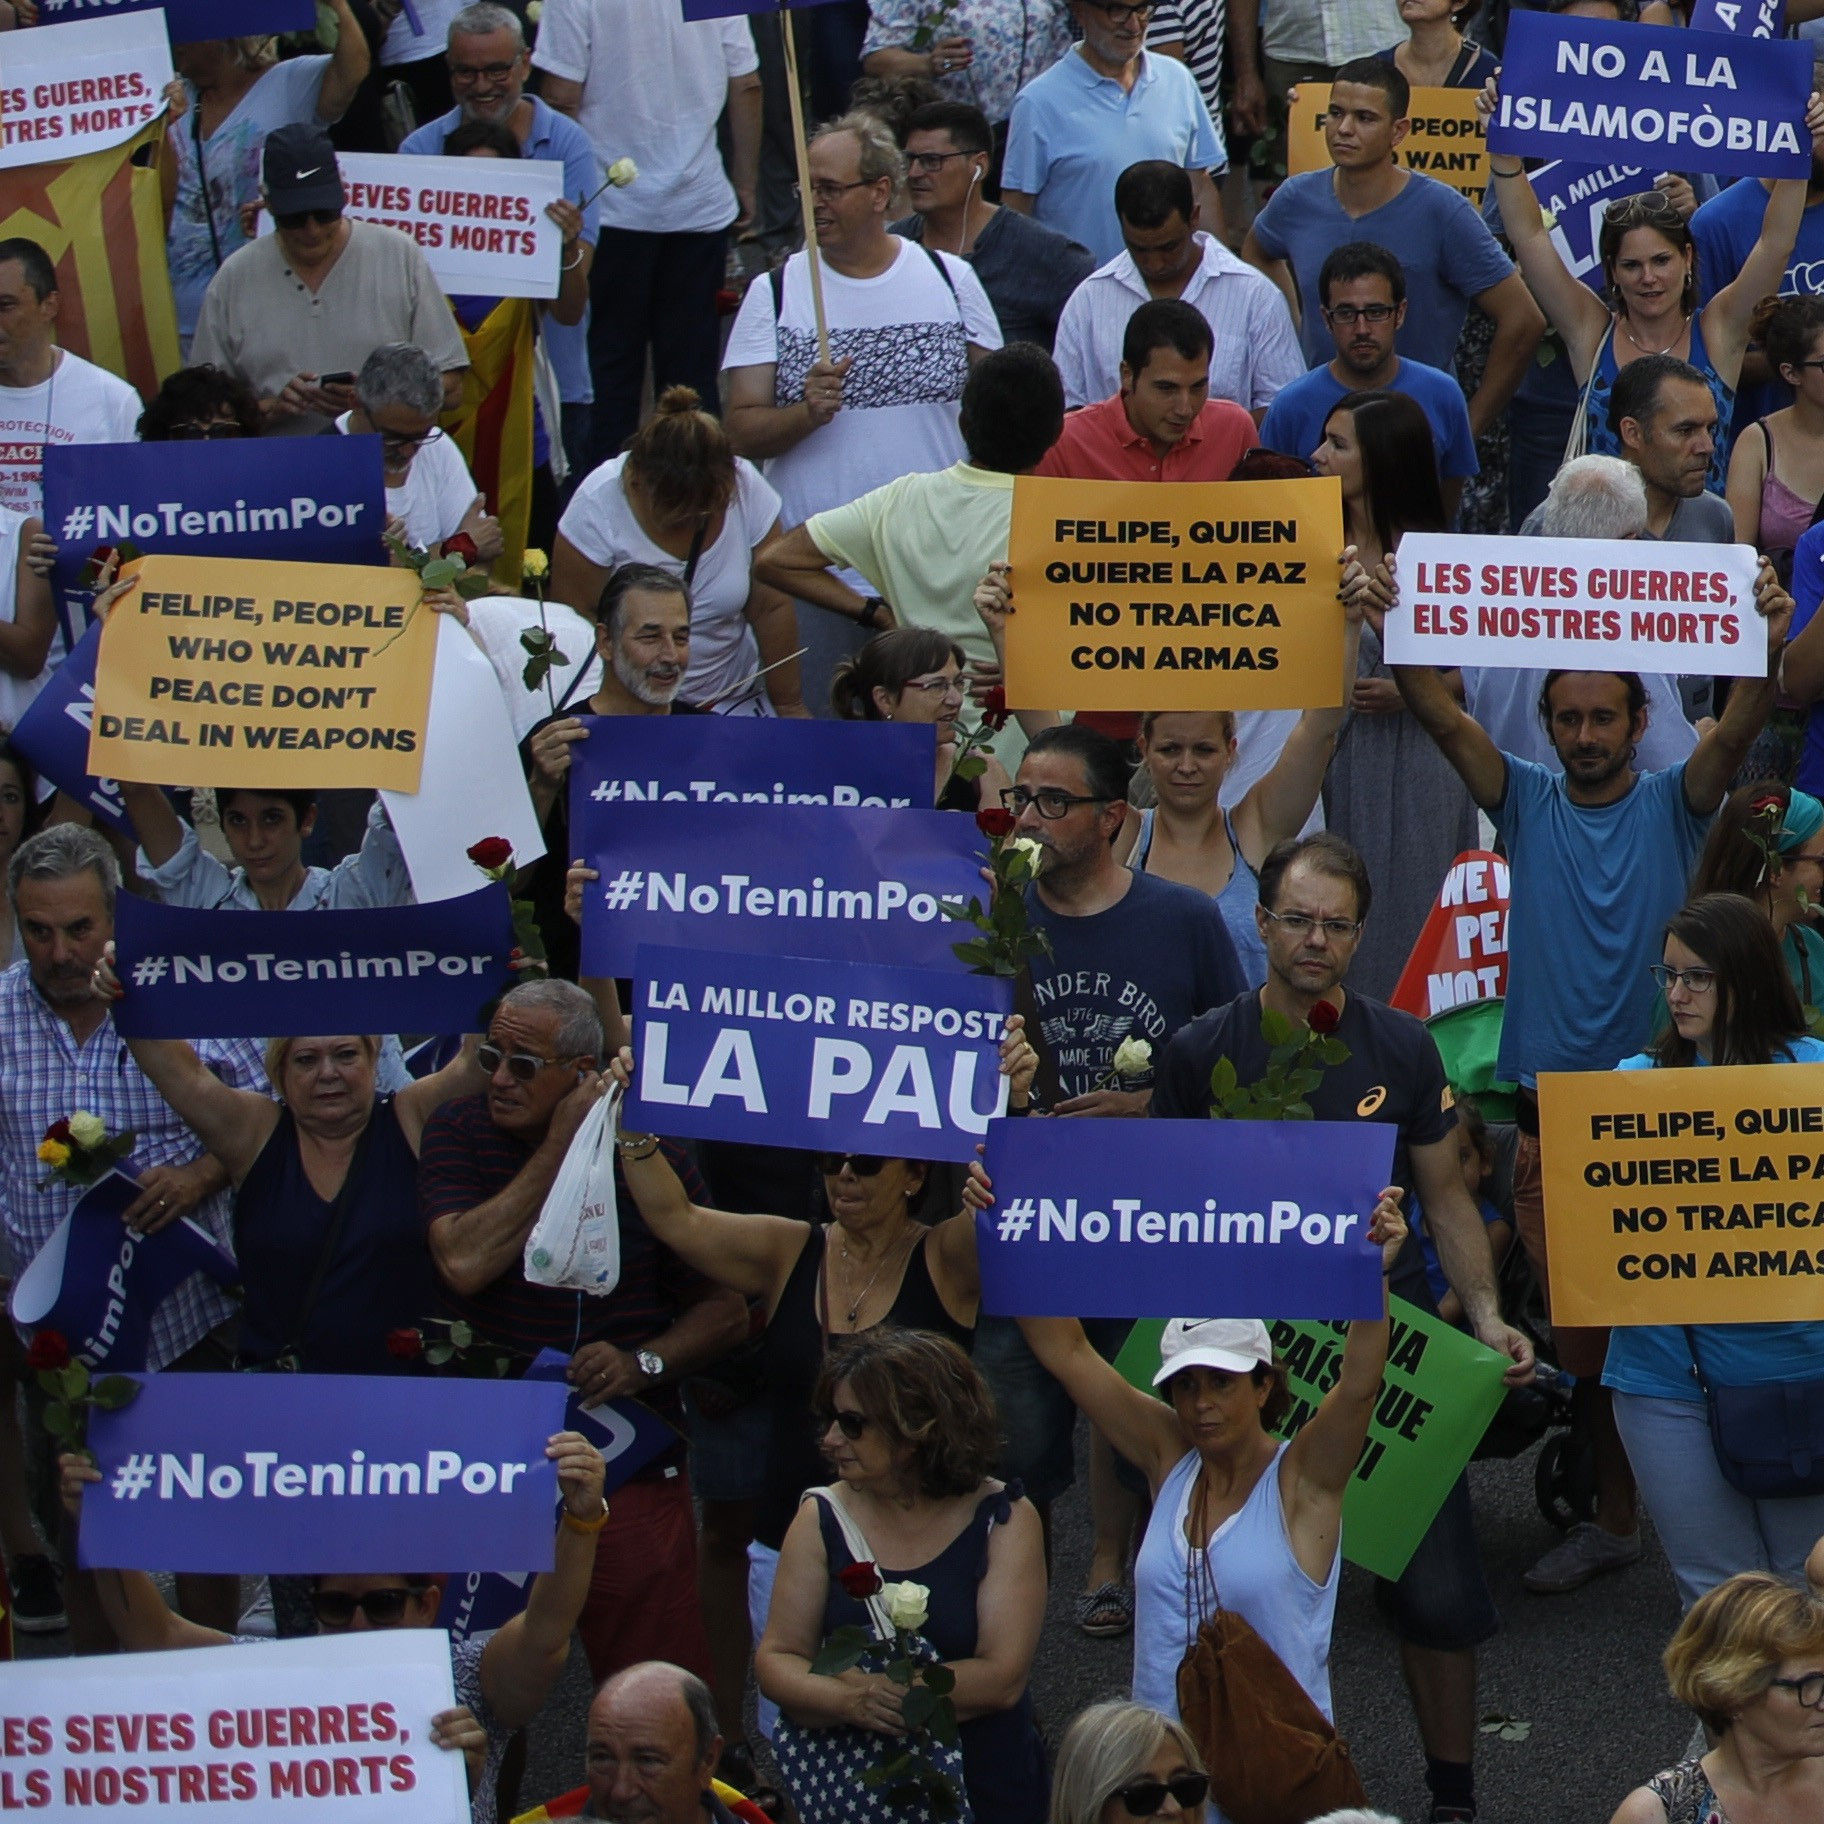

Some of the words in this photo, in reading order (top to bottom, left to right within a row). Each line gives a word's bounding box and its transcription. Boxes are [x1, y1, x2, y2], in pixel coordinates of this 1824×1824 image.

[62, 497, 364, 540] #NoTenimPor
[1055, 519, 1180, 548] FELIPE,
[1189, 520, 1296, 544] QUIEN
[1045, 561, 1173, 584] QUIERE
[1182, 562, 1227, 584] LA
[1236, 562, 1306, 584] PAZ
[1070, 602, 1121, 626] NO
[1129, 603, 1281, 628] TRAFICA
[1071, 646, 1145, 670] CON
[1153, 646, 1279, 671] ARMAS
[1118, 981, 1166, 1038] BIRD
[997, 1198, 1358, 1245] #NoTenimPor
[111, 1450, 527, 1499] #NoTenimPor
